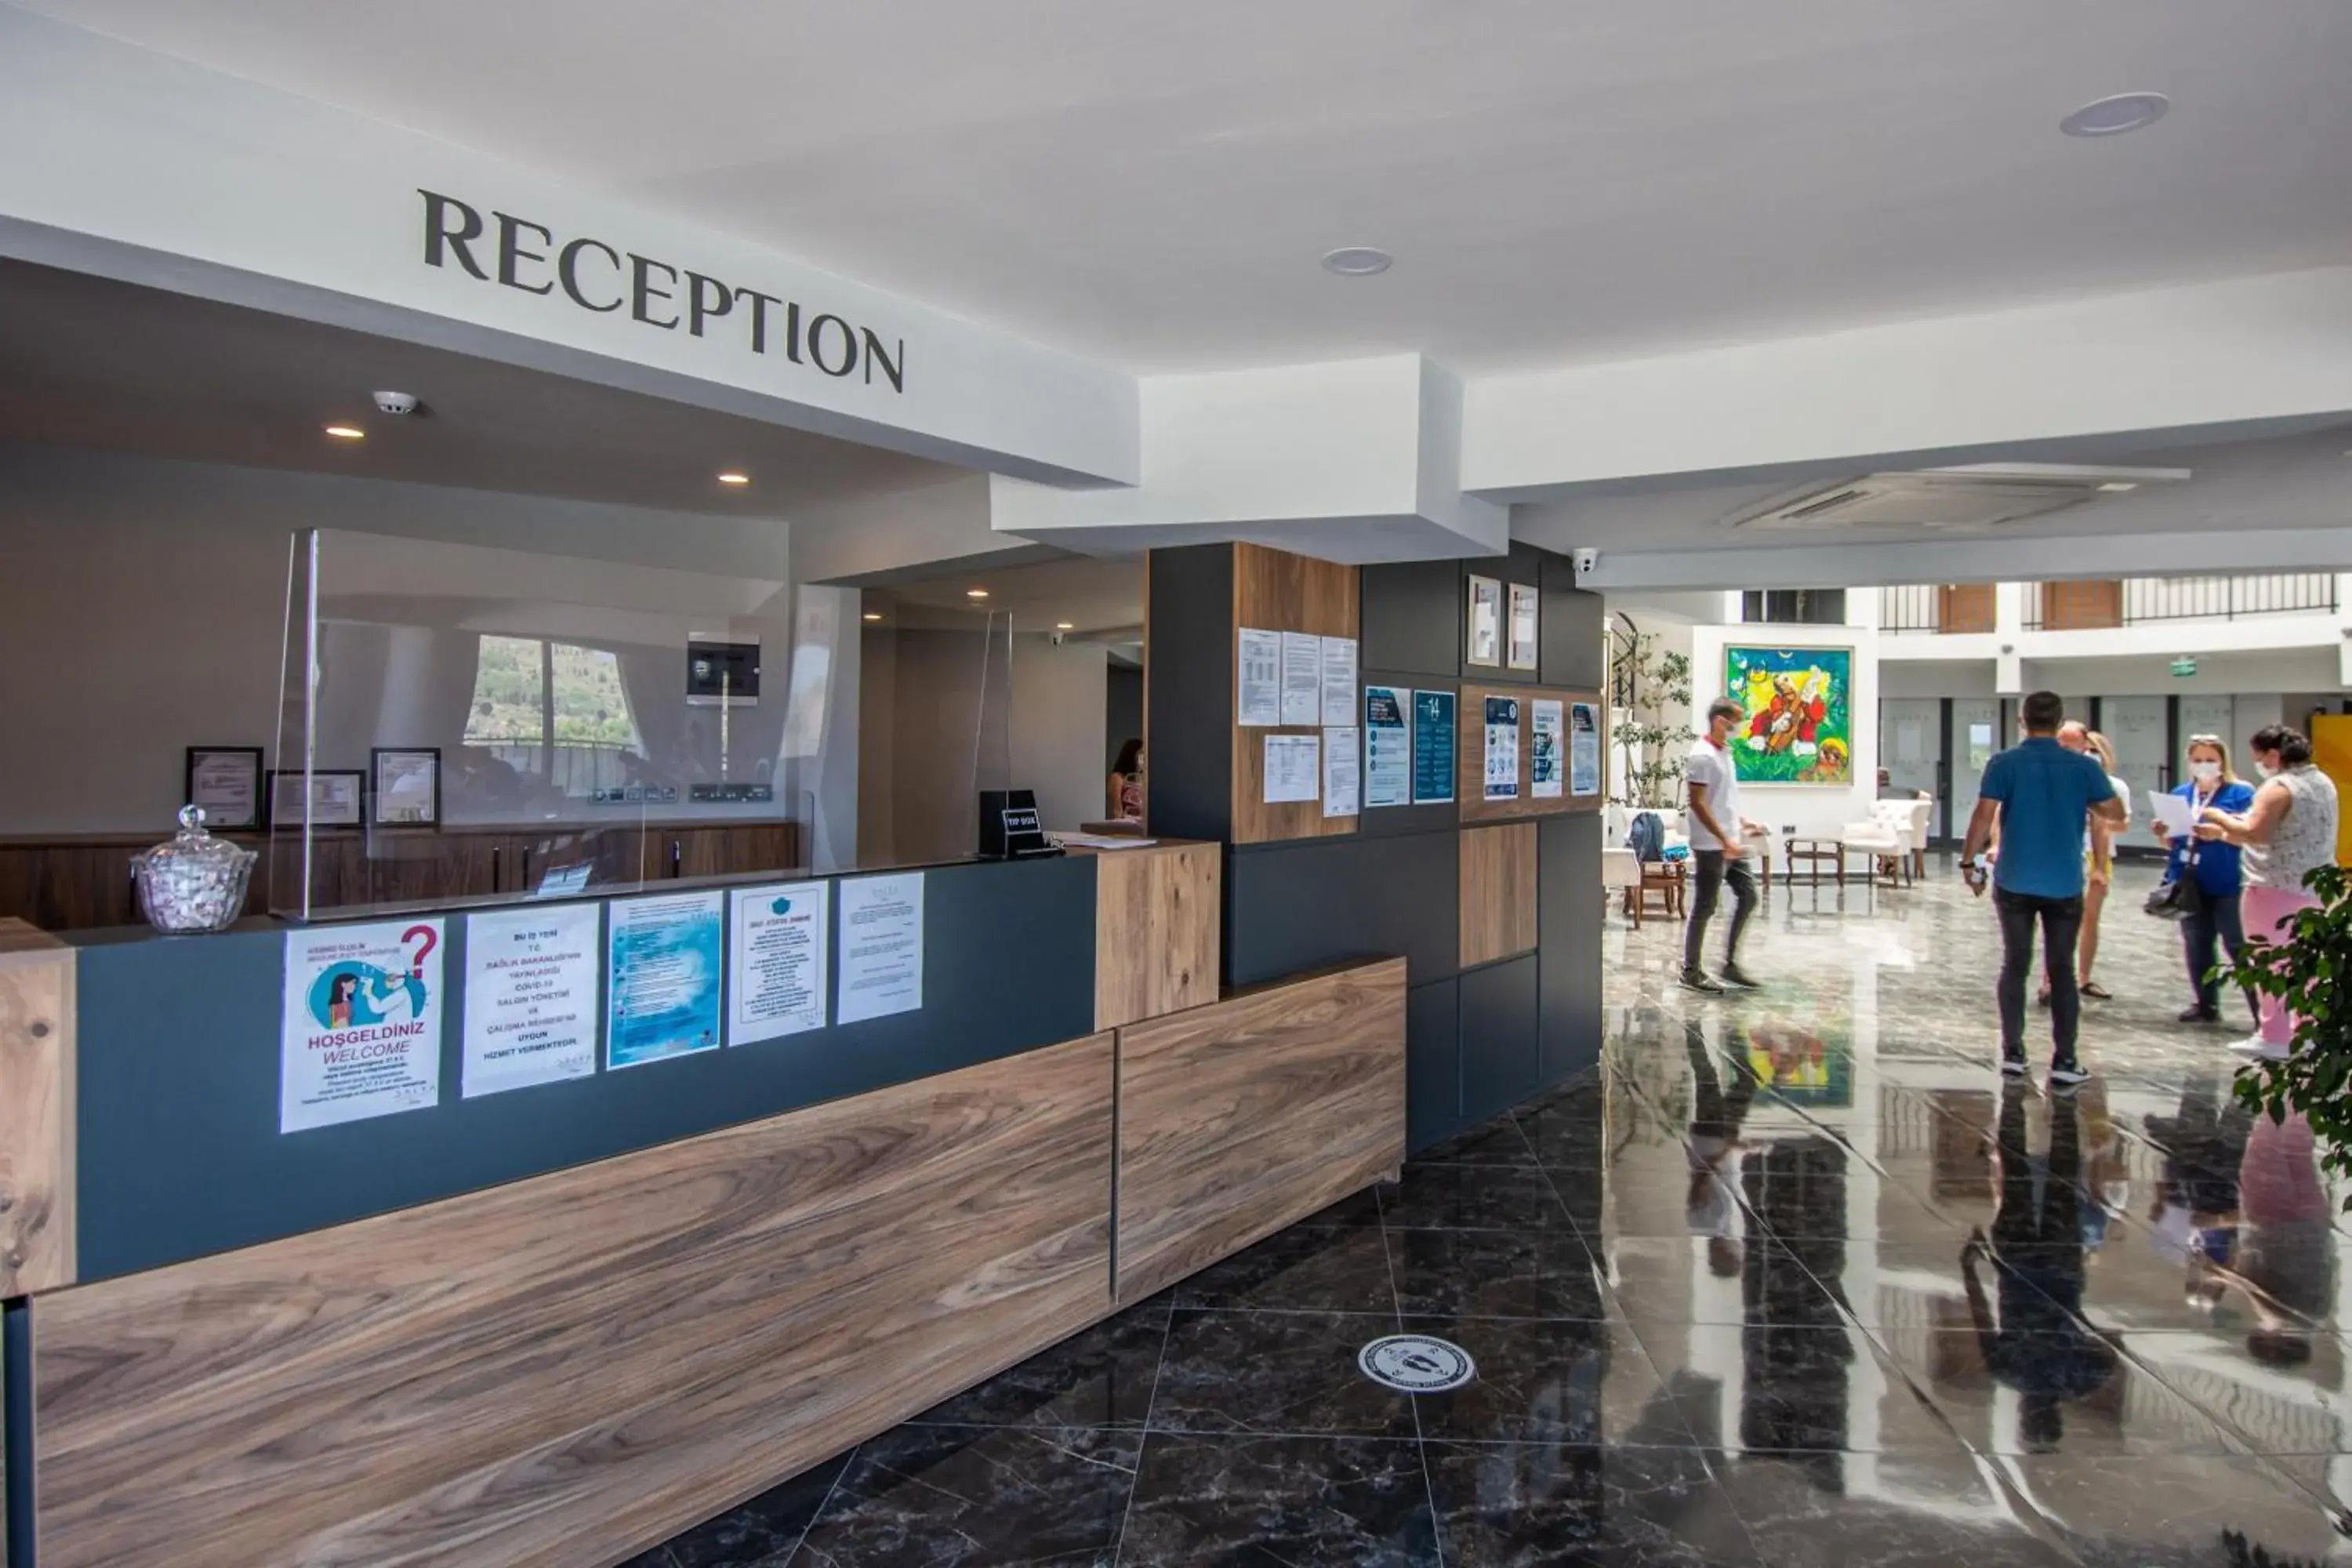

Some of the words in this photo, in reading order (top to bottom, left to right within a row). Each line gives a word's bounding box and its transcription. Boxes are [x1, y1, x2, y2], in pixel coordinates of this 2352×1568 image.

[416, 187, 904, 394] RECEPTION
[1008, 818, 1019, 826] TIP
[1020, 817, 1035, 826] BOX
[308, 1022, 425, 1050] HOŞGELDİNİZ
[517, 1031, 548, 1042] UYGUN
[323, 1040, 411, 1065] WELCOME
